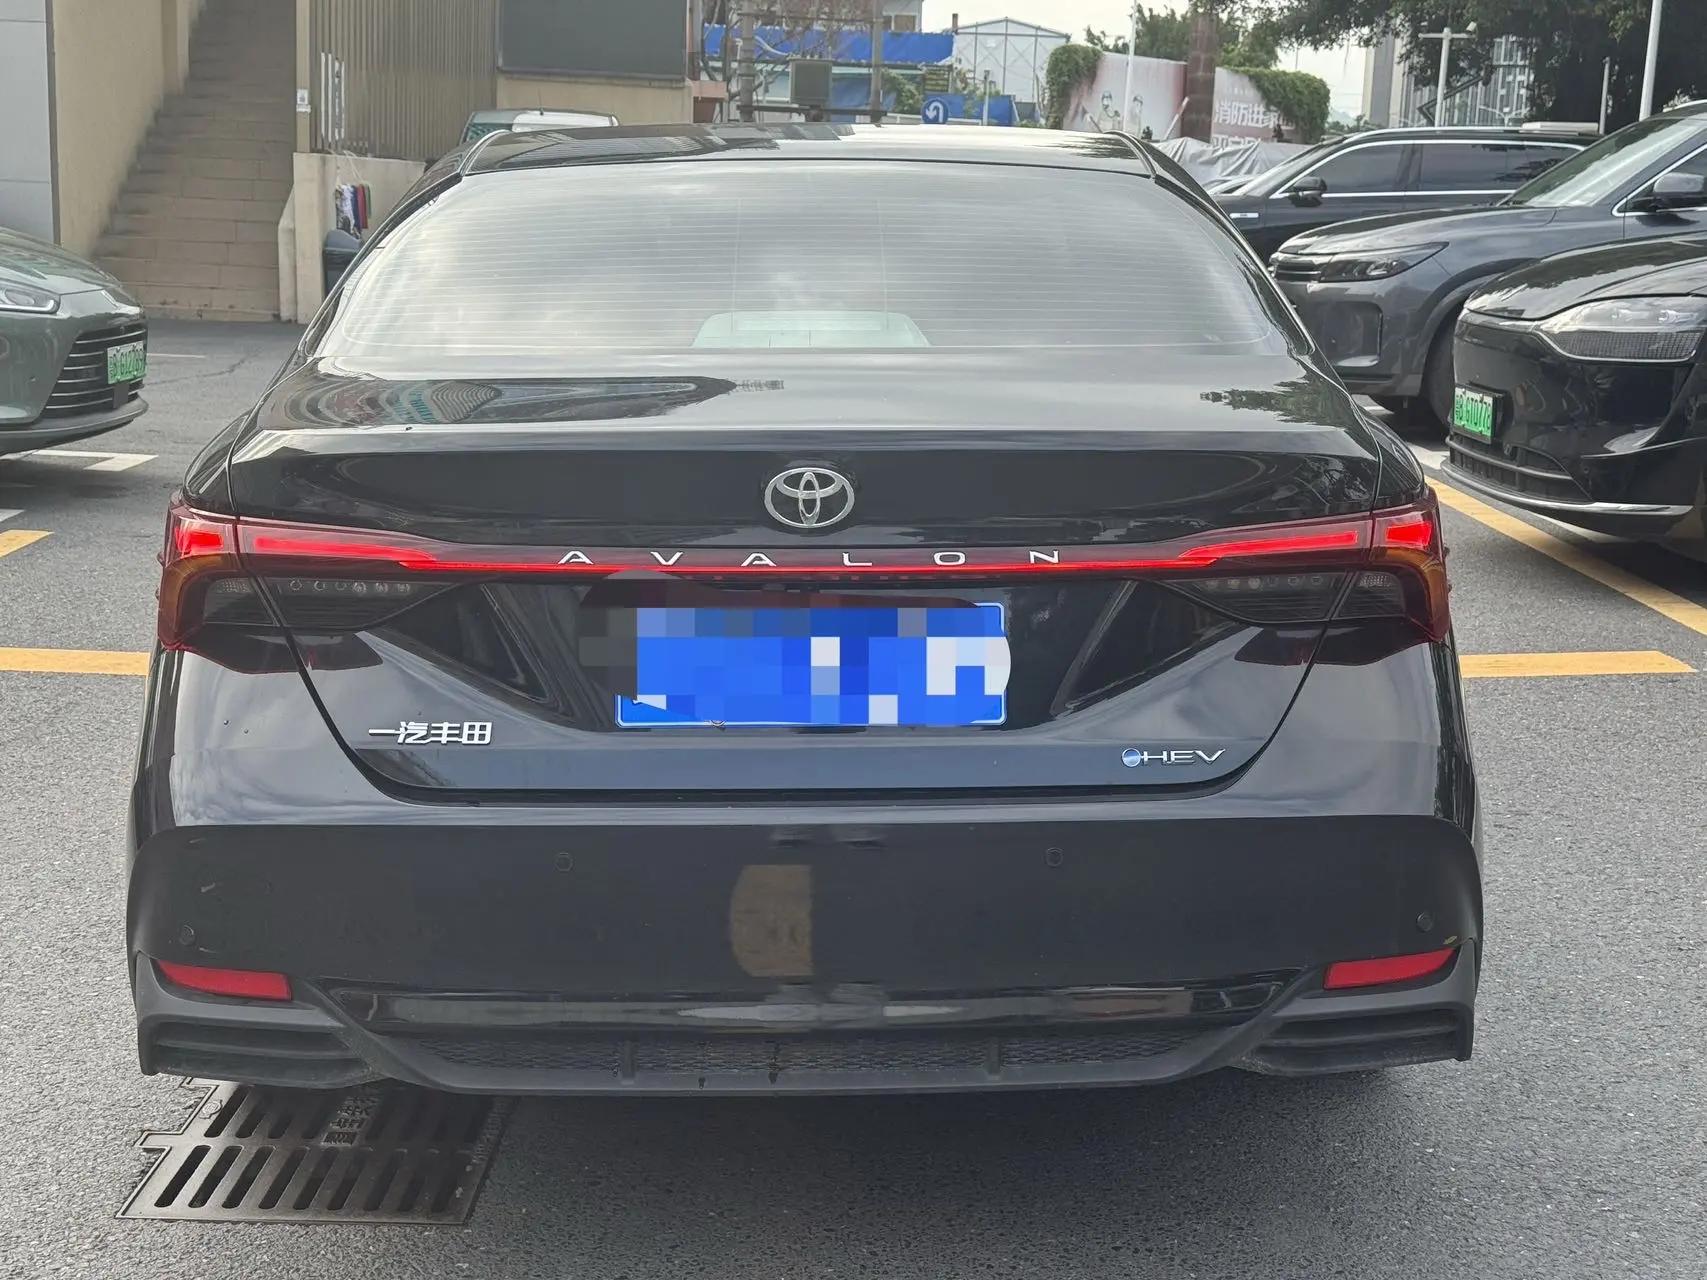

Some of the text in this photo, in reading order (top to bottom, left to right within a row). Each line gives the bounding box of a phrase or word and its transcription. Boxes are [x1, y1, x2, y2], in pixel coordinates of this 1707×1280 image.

[557, 550, 1060, 566] AVALON
[368, 721, 493, 745] 一汽丰田
[1142, 748, 1226, 765] HEV
